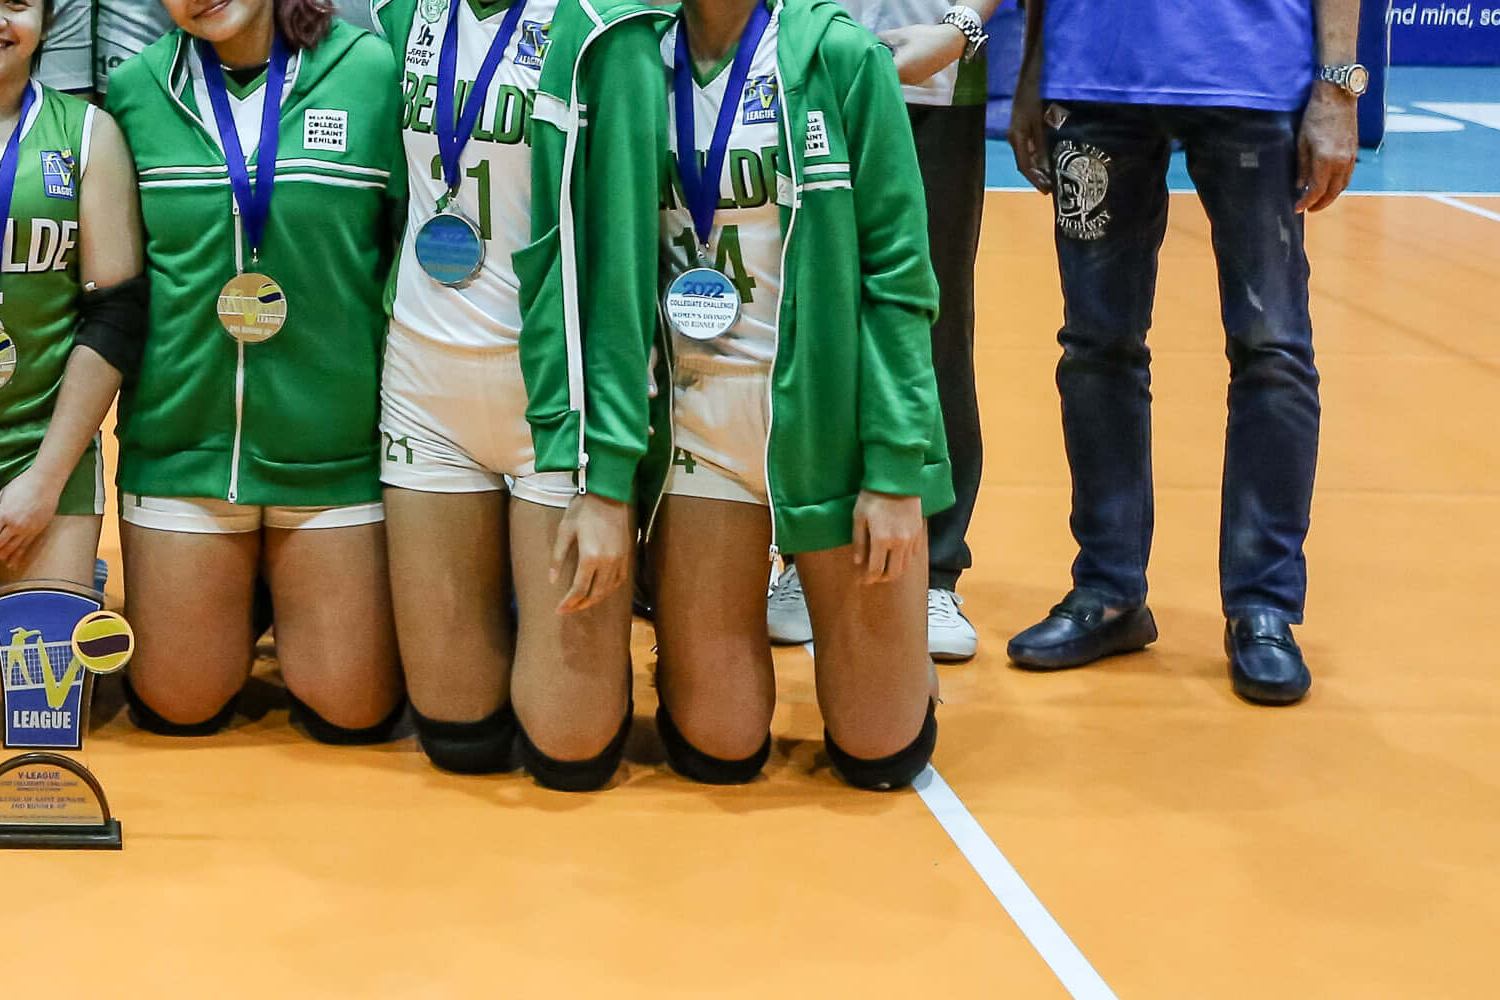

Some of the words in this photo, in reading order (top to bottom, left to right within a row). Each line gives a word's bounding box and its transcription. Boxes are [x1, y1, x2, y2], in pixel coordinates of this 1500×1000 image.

[1420, 2, 1474, 29] mind,
[746, 110, 776, 121] LEAGUE
[308, 121, 343, 130] COLLEGE
[308, 137, 343, 146] BENILDE
[48, 184, 74, 197] LEAGUE
[431, 155, 492, 241] 21
[673, 224, 756, 303] 14
[683, 281, 725, 298] 2022
[13, 710, 72, 730] LEAGUE
